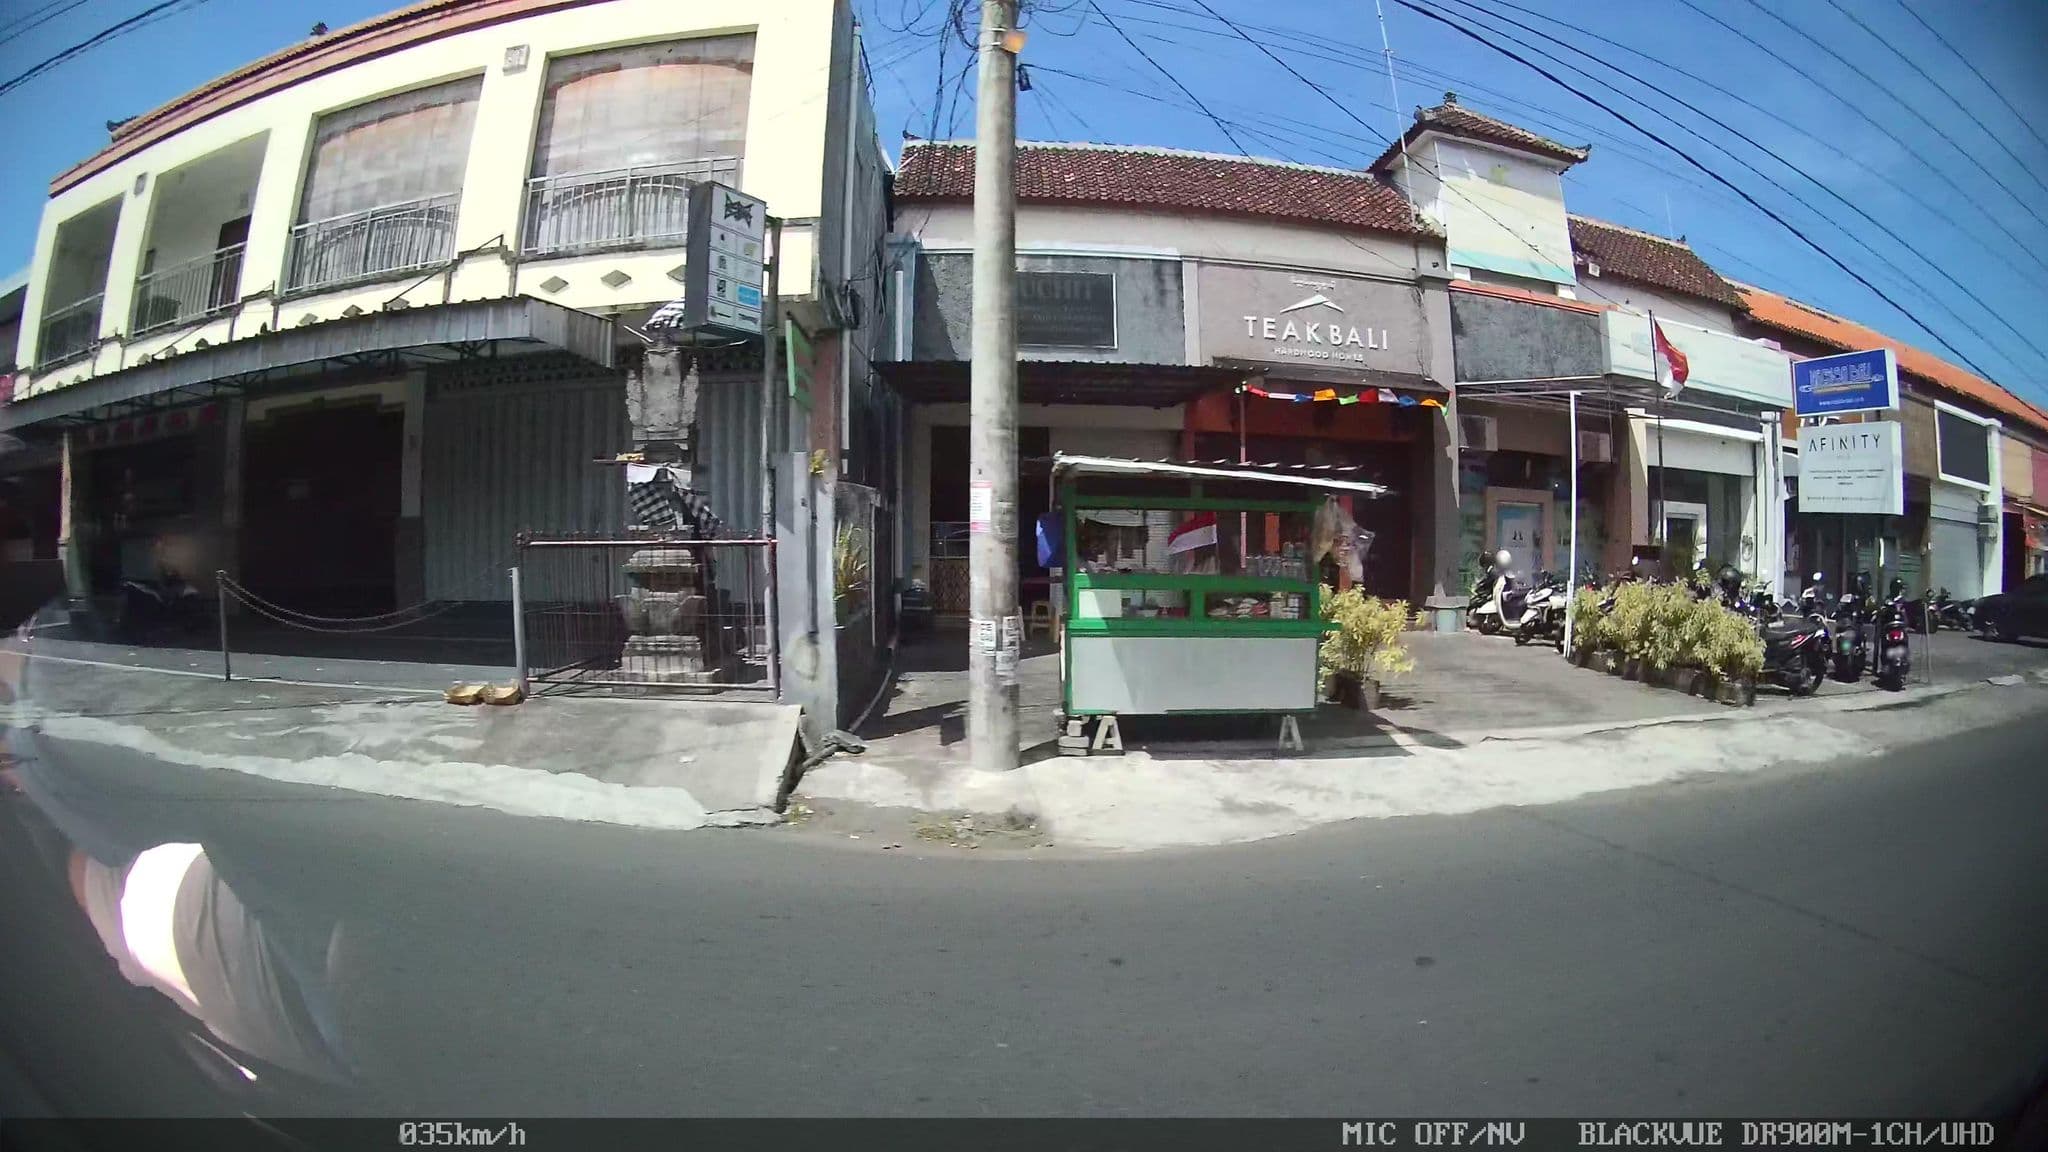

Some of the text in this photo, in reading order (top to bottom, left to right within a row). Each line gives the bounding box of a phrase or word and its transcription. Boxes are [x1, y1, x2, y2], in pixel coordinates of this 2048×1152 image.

[1243, 315, 1389, 351] TEAK BALI
[1808, 433, 1882, 453] AFINITY
